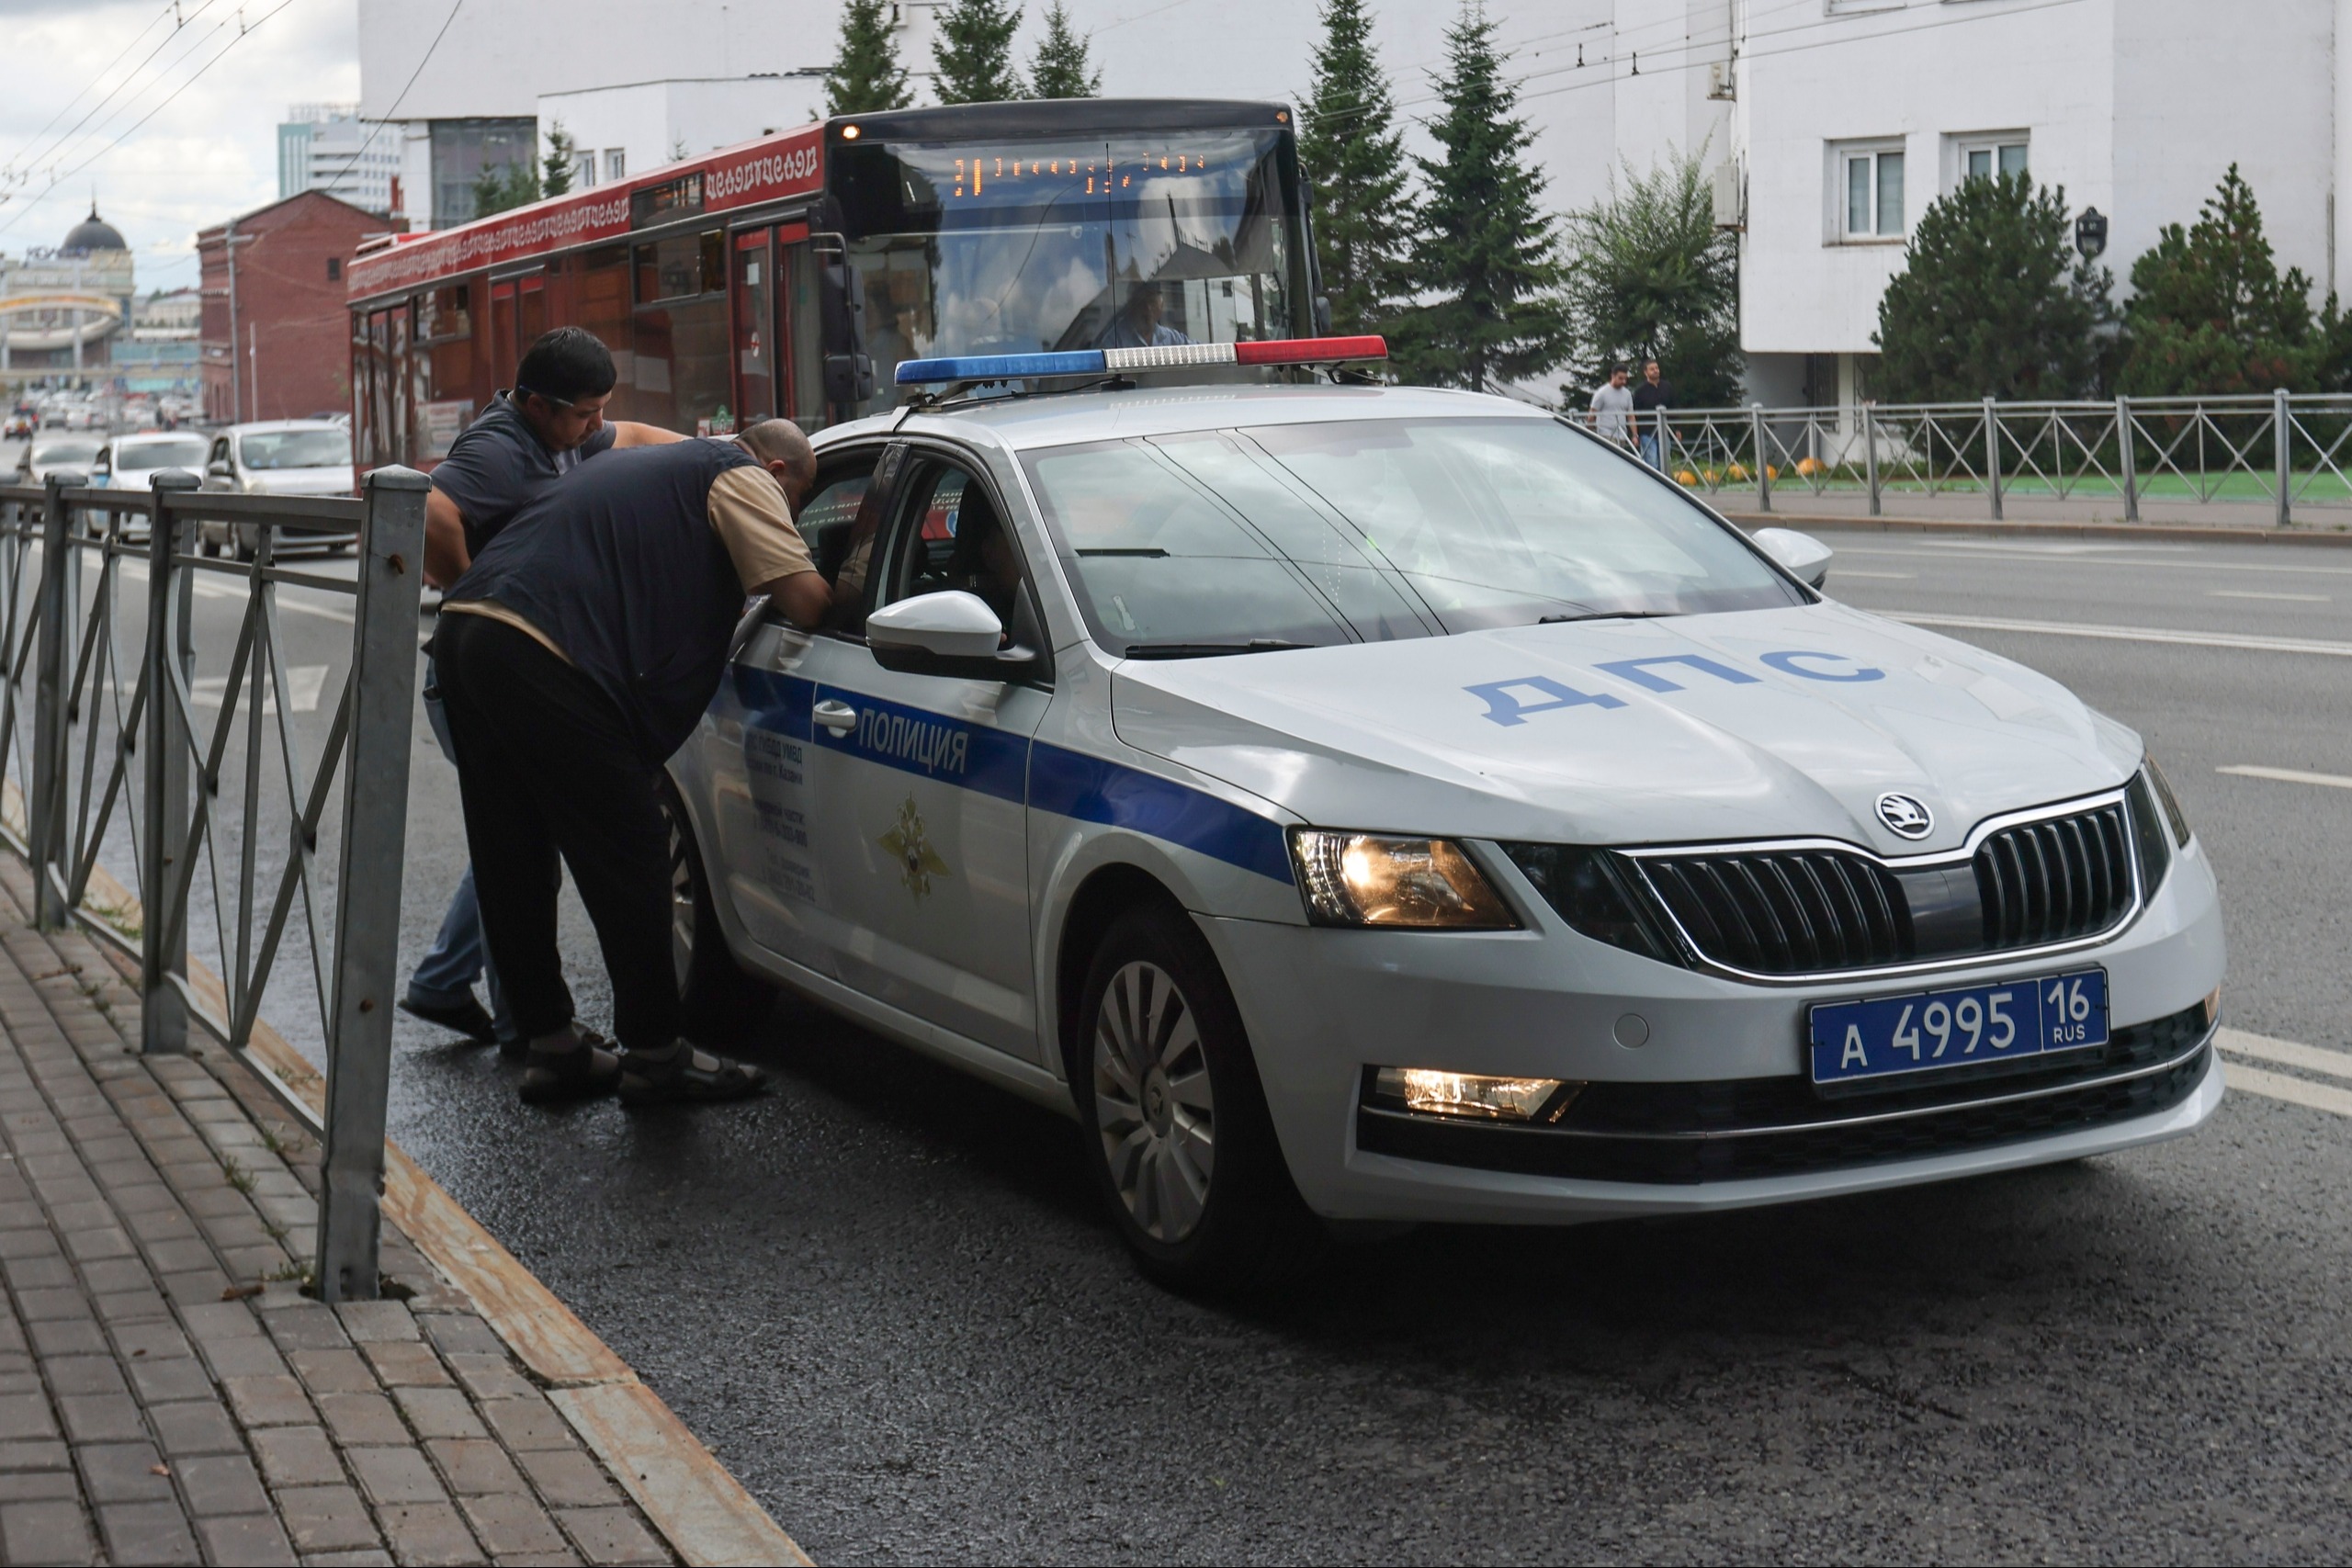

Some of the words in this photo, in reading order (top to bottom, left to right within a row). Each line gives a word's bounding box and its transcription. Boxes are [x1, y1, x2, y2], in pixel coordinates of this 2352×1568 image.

[1461, 650, 1886, 727] ДПС
[782, 742, 802, 766] УМВД
[860, 707, 968, 773] ПОЛИЦИЯ
[1892, 992, 2016, 1061] 4995
[2048, 978, 2090, 1024] 16
[2053, 1024, 2086, 1044] RUS
